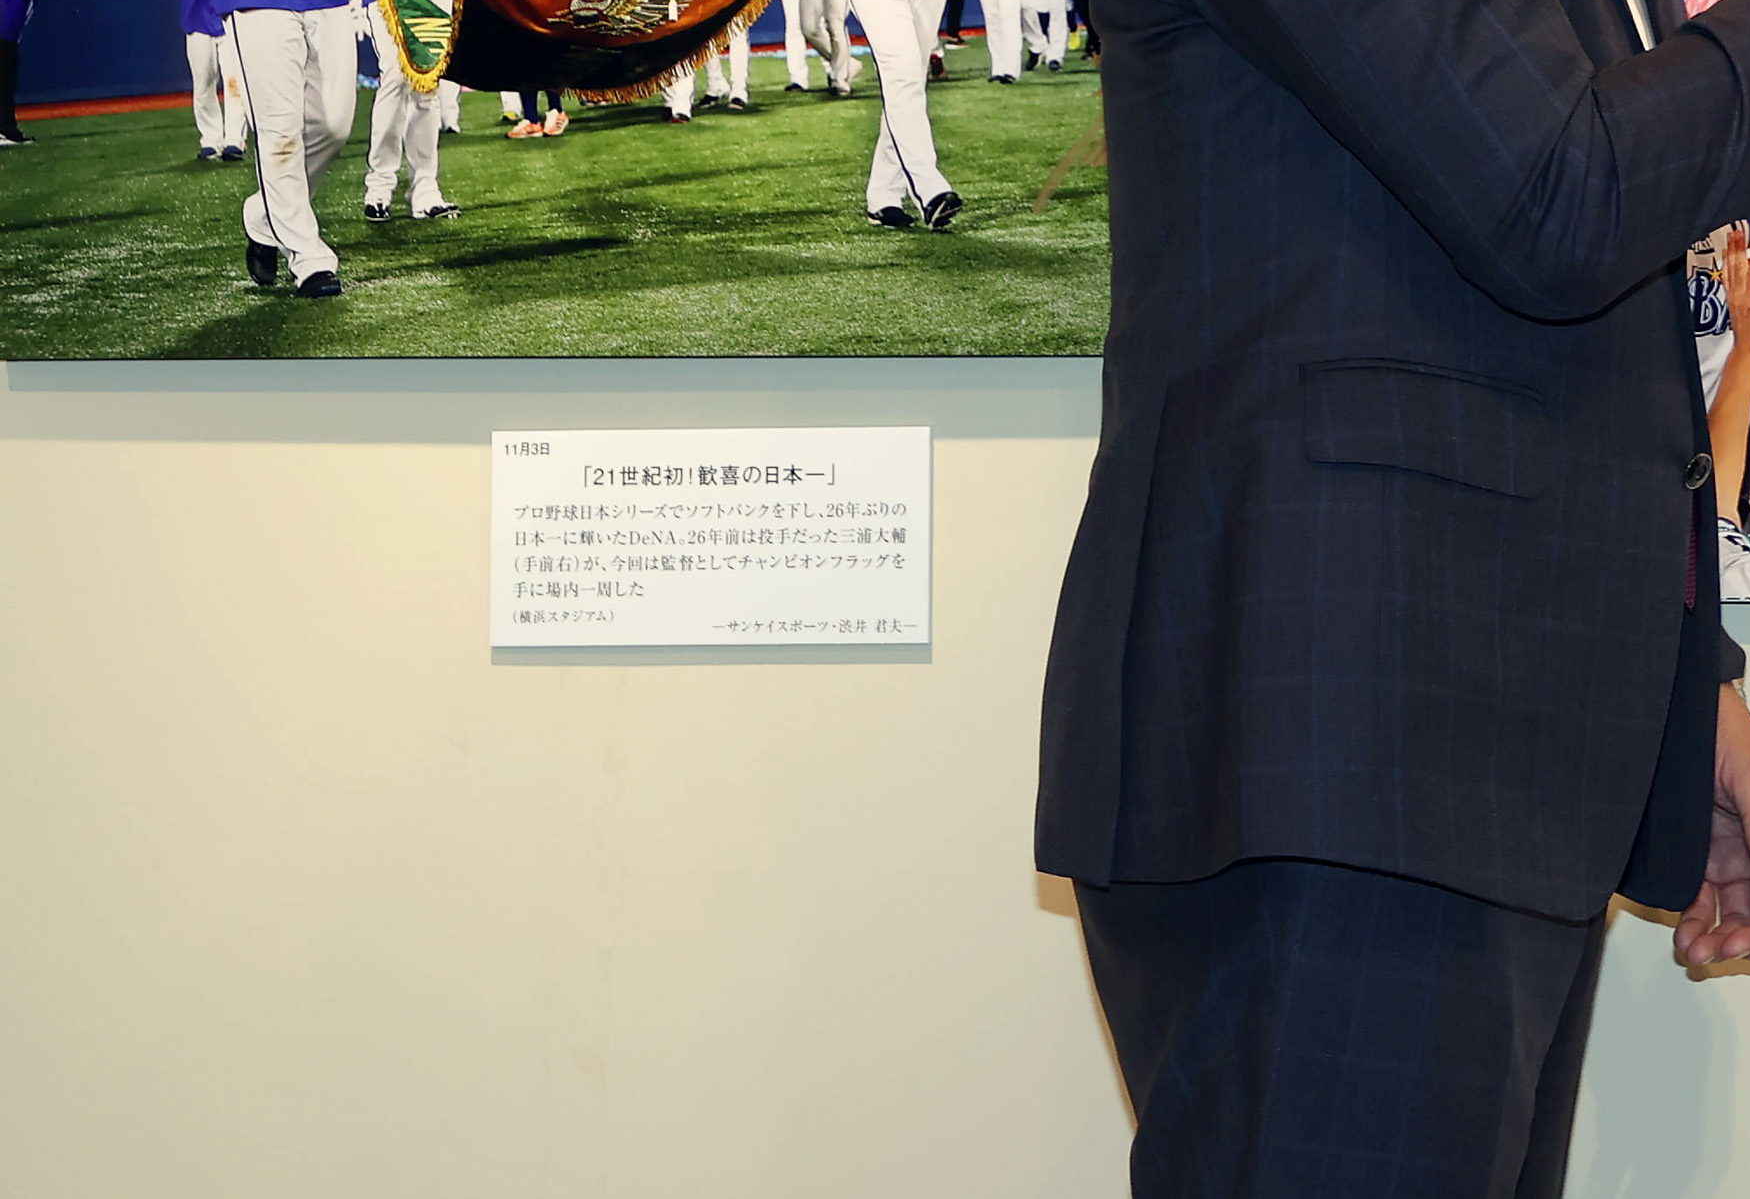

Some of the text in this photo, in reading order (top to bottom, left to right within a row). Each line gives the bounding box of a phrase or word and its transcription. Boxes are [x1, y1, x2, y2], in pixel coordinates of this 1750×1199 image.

[504, 441, 551, 457] 11月3日
[513, 580, 644, 599] 手に場内一周した
